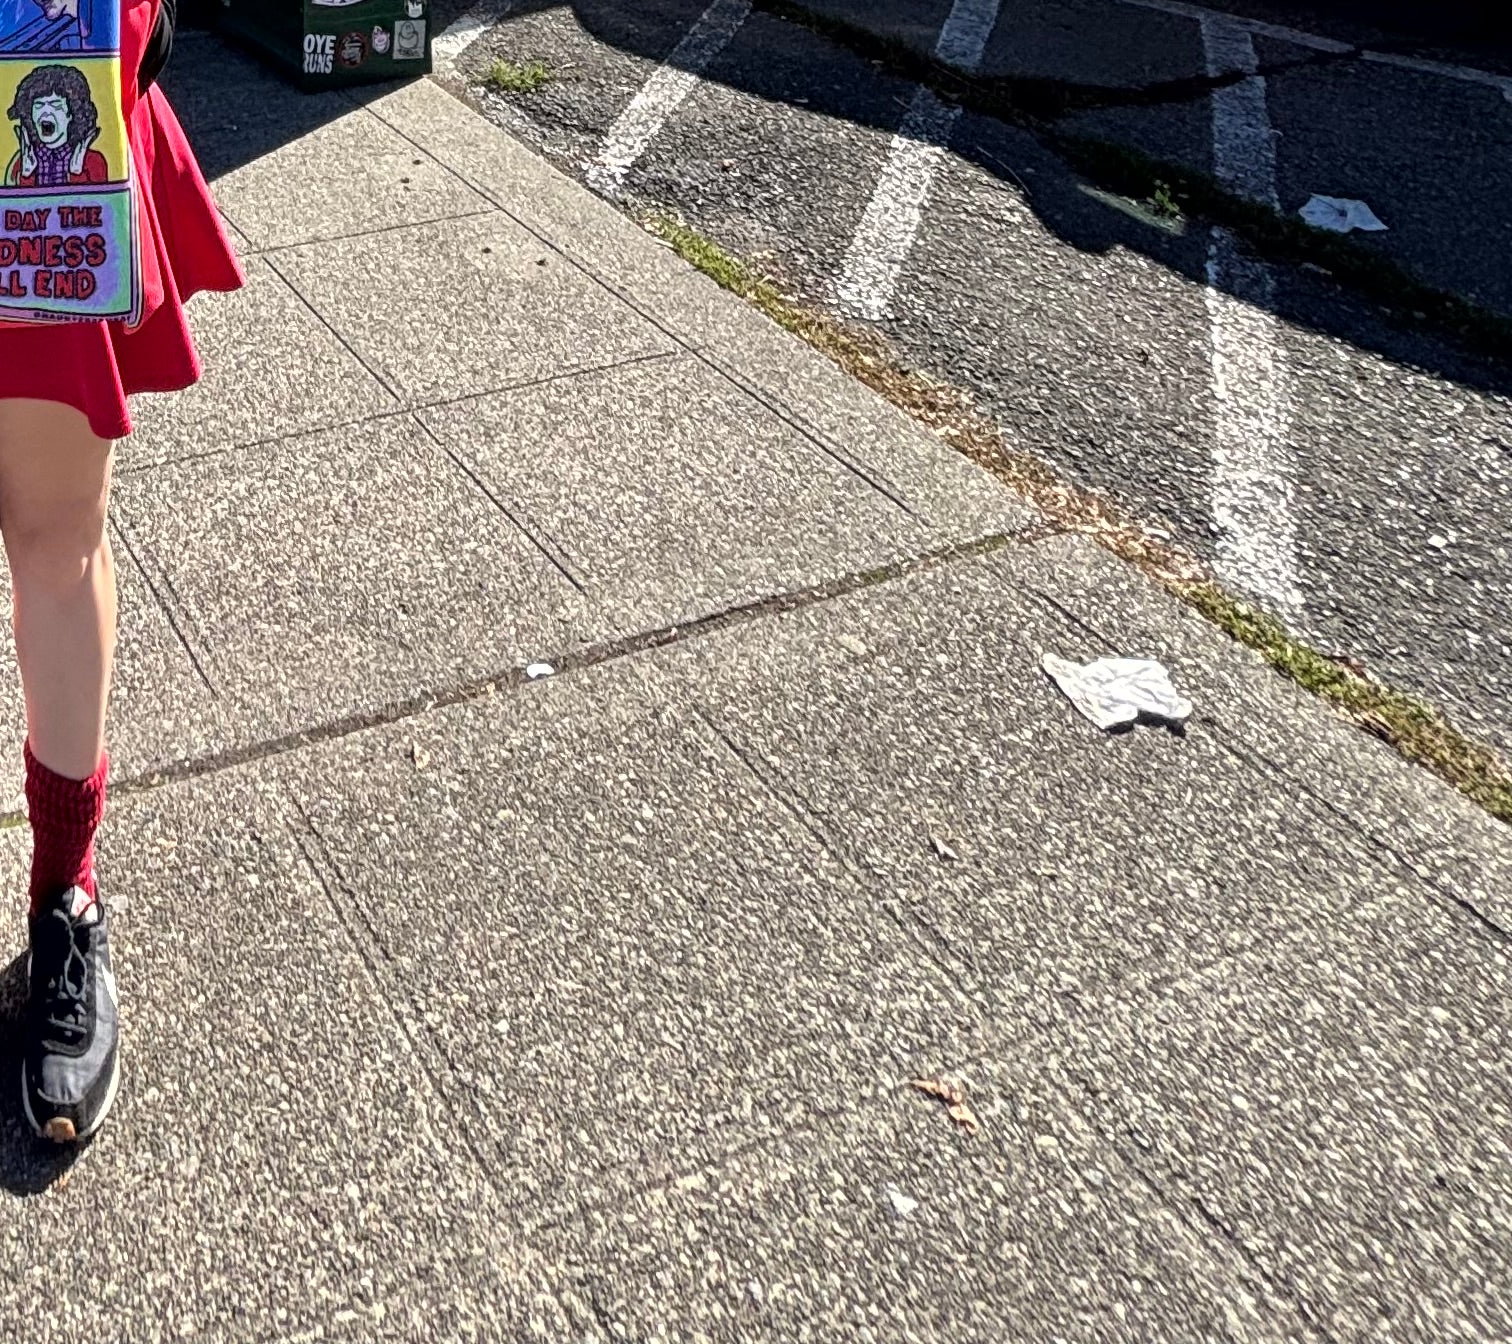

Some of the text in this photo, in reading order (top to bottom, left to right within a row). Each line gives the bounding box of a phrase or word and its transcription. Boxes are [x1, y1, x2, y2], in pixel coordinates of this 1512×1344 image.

[303, 34, 337, 54] OYE
[4, 208, 52, 232] DAY
[58, 205, 103, 228] THE
[34, 268, 97, 300] END
